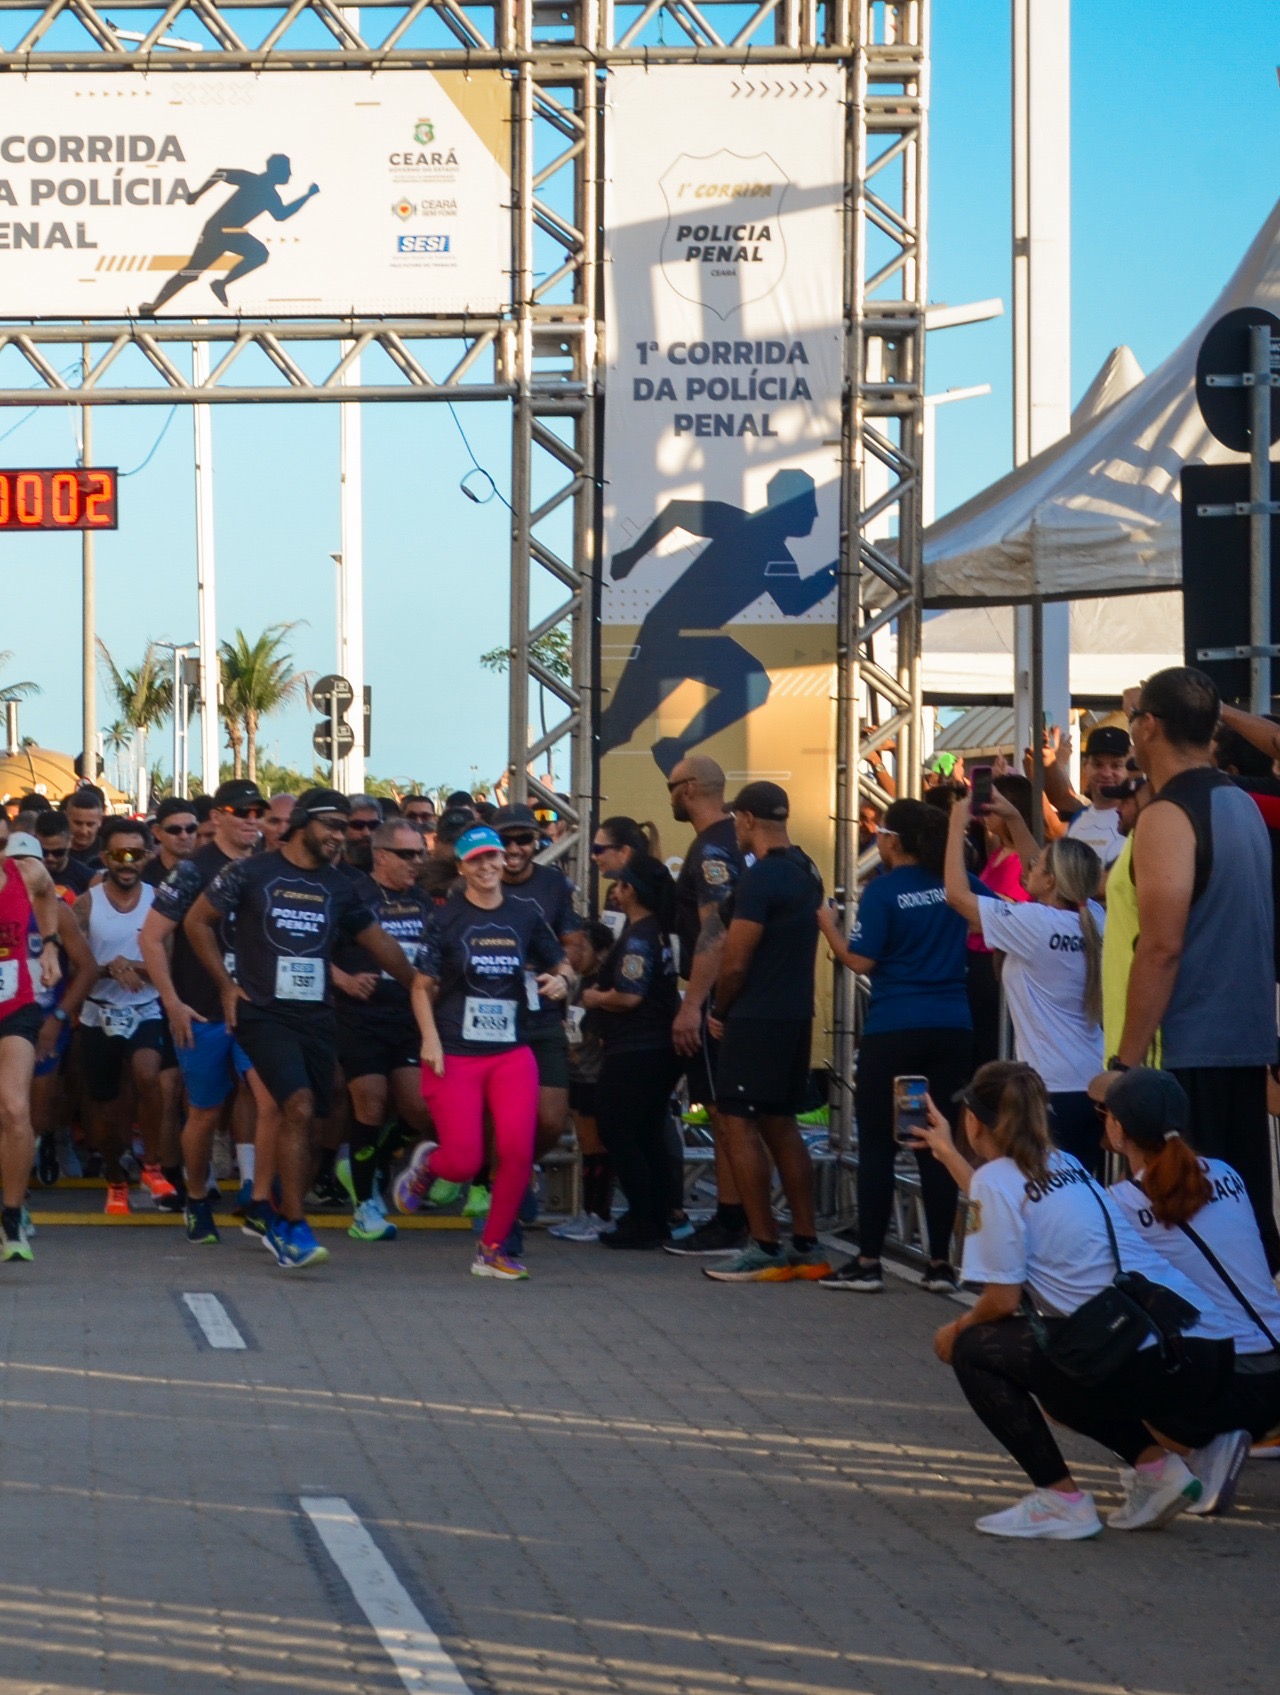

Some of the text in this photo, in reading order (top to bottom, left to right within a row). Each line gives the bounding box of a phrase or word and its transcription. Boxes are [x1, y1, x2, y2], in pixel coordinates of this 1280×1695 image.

[0, 135, 186, 164] CORRIDA
[389, 148, 459, 166] CEARÁ
[30, 167, 193, 206] POLÍCIA
[694, 183, 772, 198] CORRIDA
[421, 198, 458, 209] CEARÁ
[676, 225, 772, 242] POLICIA
[400, 236, 448, 252] SESI
[685, 246, 763, 262] PENAL
[636, 341, 809, 365] 1ª CORRIDA
[633, 368, 812, 401] DA POLÍCIA
[674, 413, 778, 437] PENAL
[271, 907, 325, 922] POLICIA
[276, 919, 319, 932] PENAL
